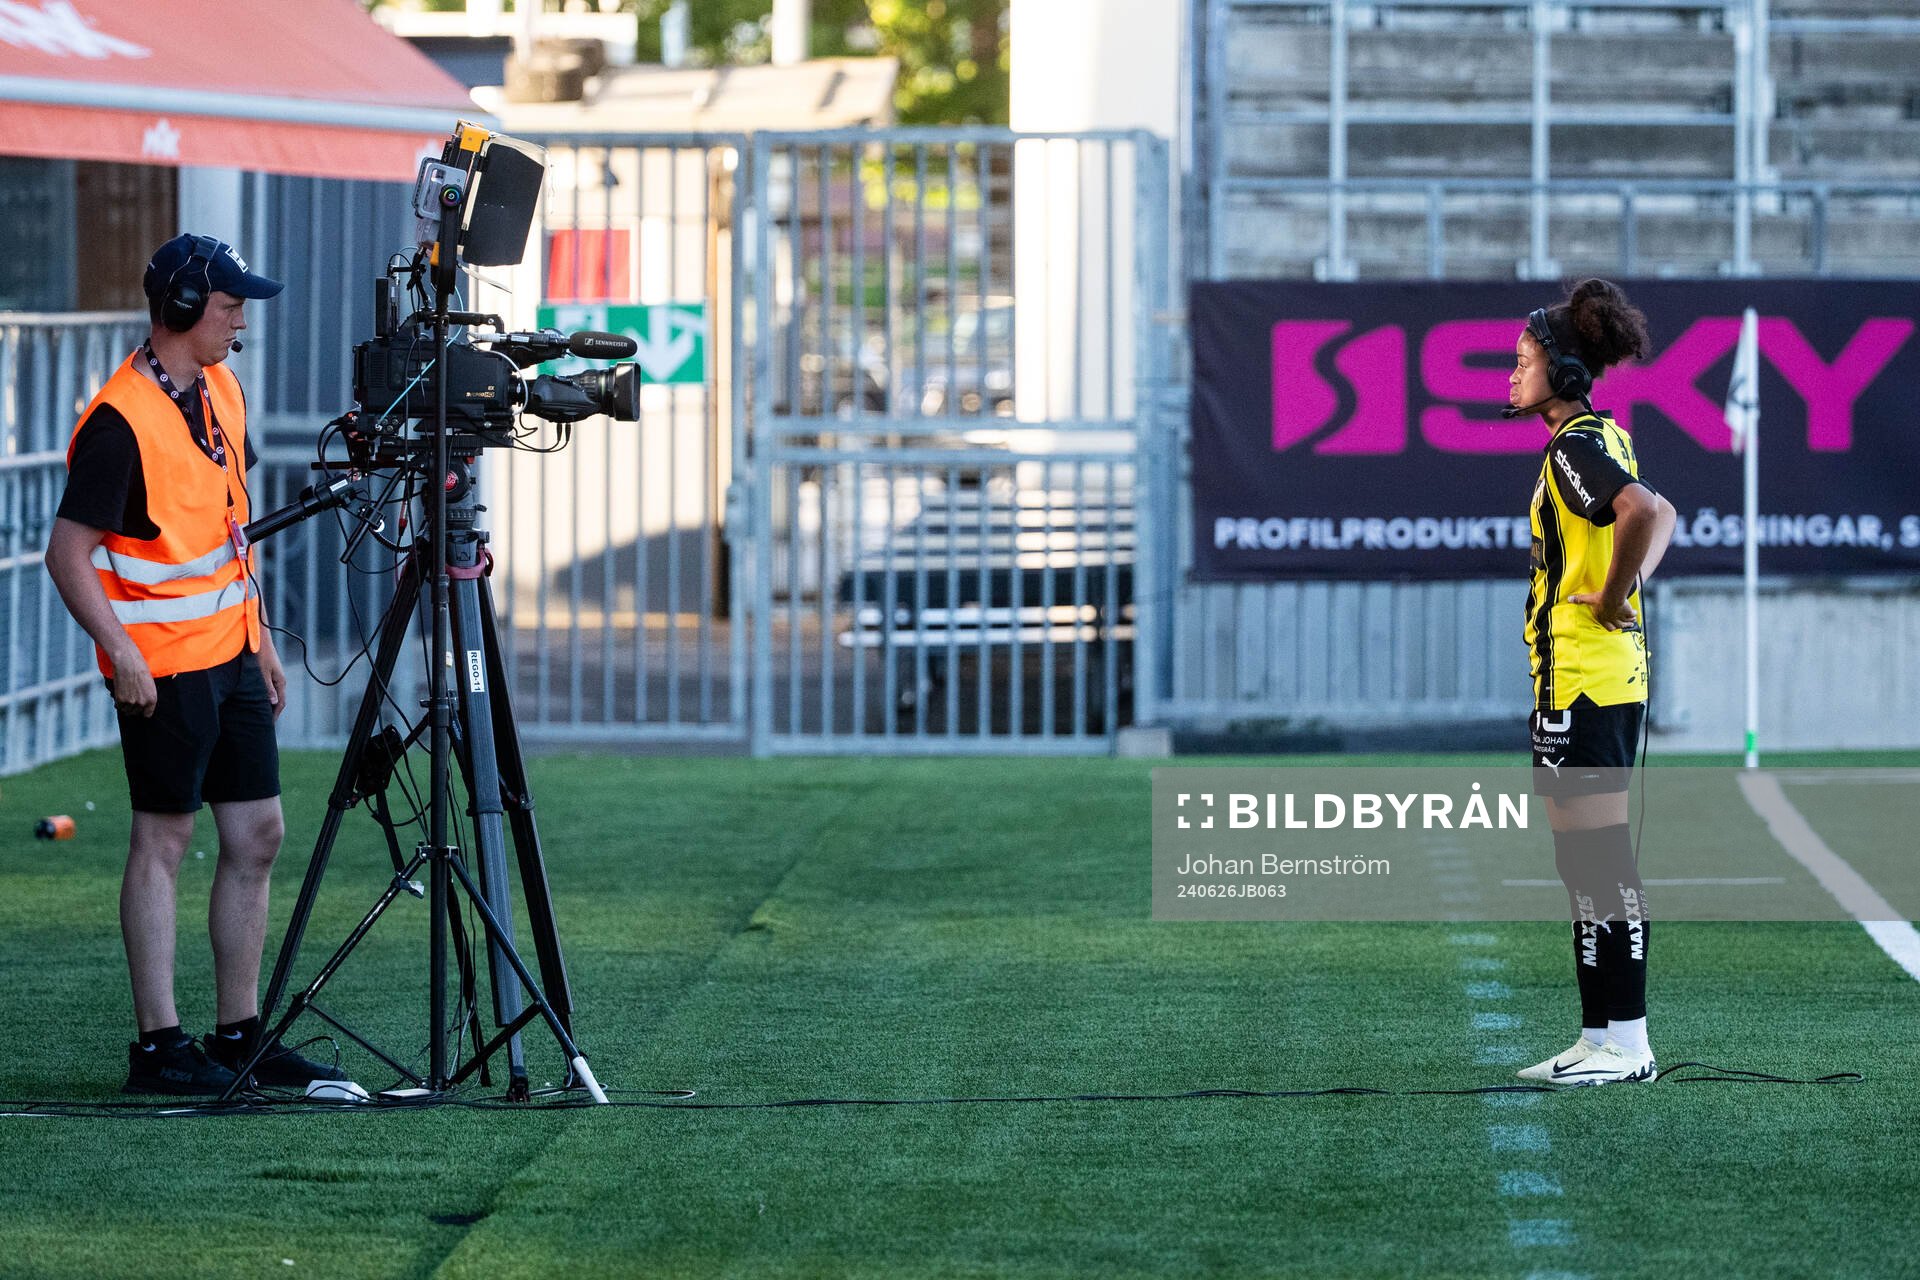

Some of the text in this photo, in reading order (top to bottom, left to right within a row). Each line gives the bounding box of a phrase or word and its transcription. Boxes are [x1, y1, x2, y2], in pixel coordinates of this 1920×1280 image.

[595, 339, 628, 348] SENNHEISER
[1554, 449, 1595, 508] stadium
[1214, 517, 1532, 549] PROFILPRODUKTE
[471, 651, 481, 691] REGO-11
[1542, 736, 1570, 745] JOHAN
[1576, 893, 1597, 968] MAXXIS
[1620, 887, 1644, 960] MAXXIS
